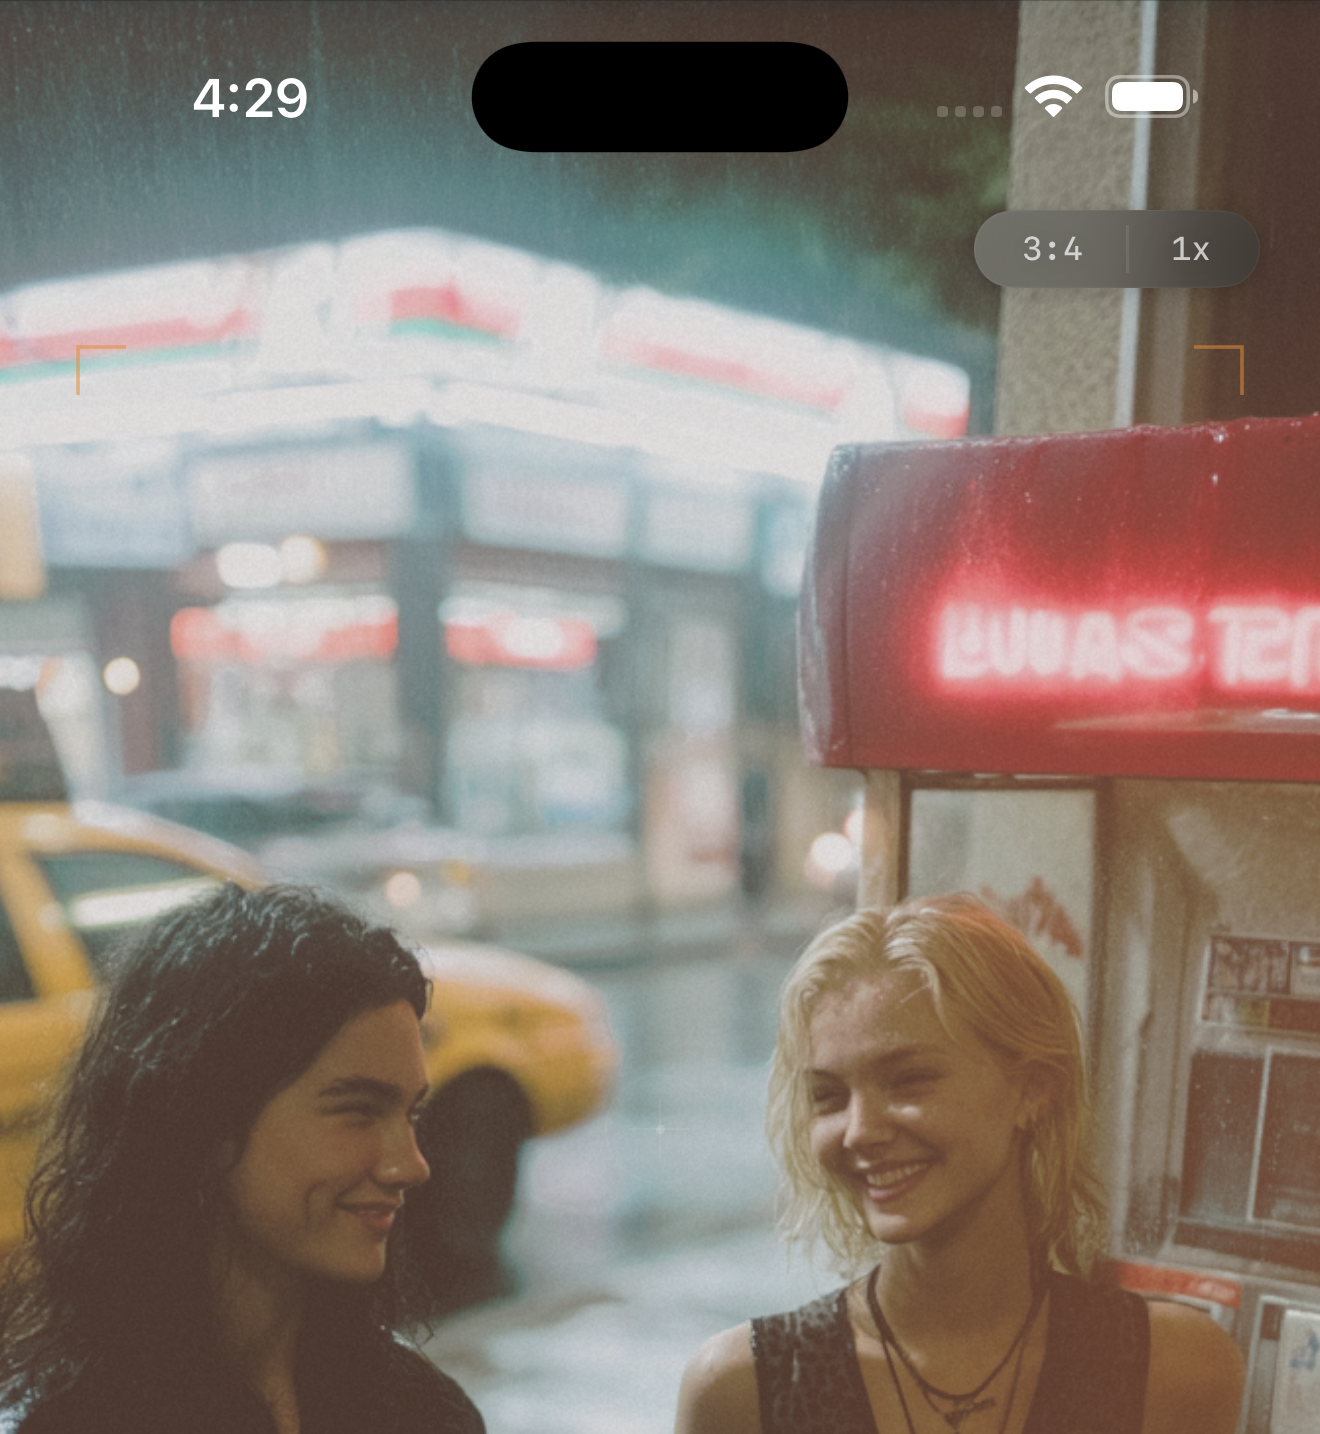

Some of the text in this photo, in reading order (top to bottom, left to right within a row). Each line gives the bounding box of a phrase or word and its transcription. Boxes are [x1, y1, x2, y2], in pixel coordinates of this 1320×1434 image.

[193, 77, 308, 119] 4:29
[1023, 235, 1083, 262] 3:4
[1172, 236, 1211, 261] 1x
